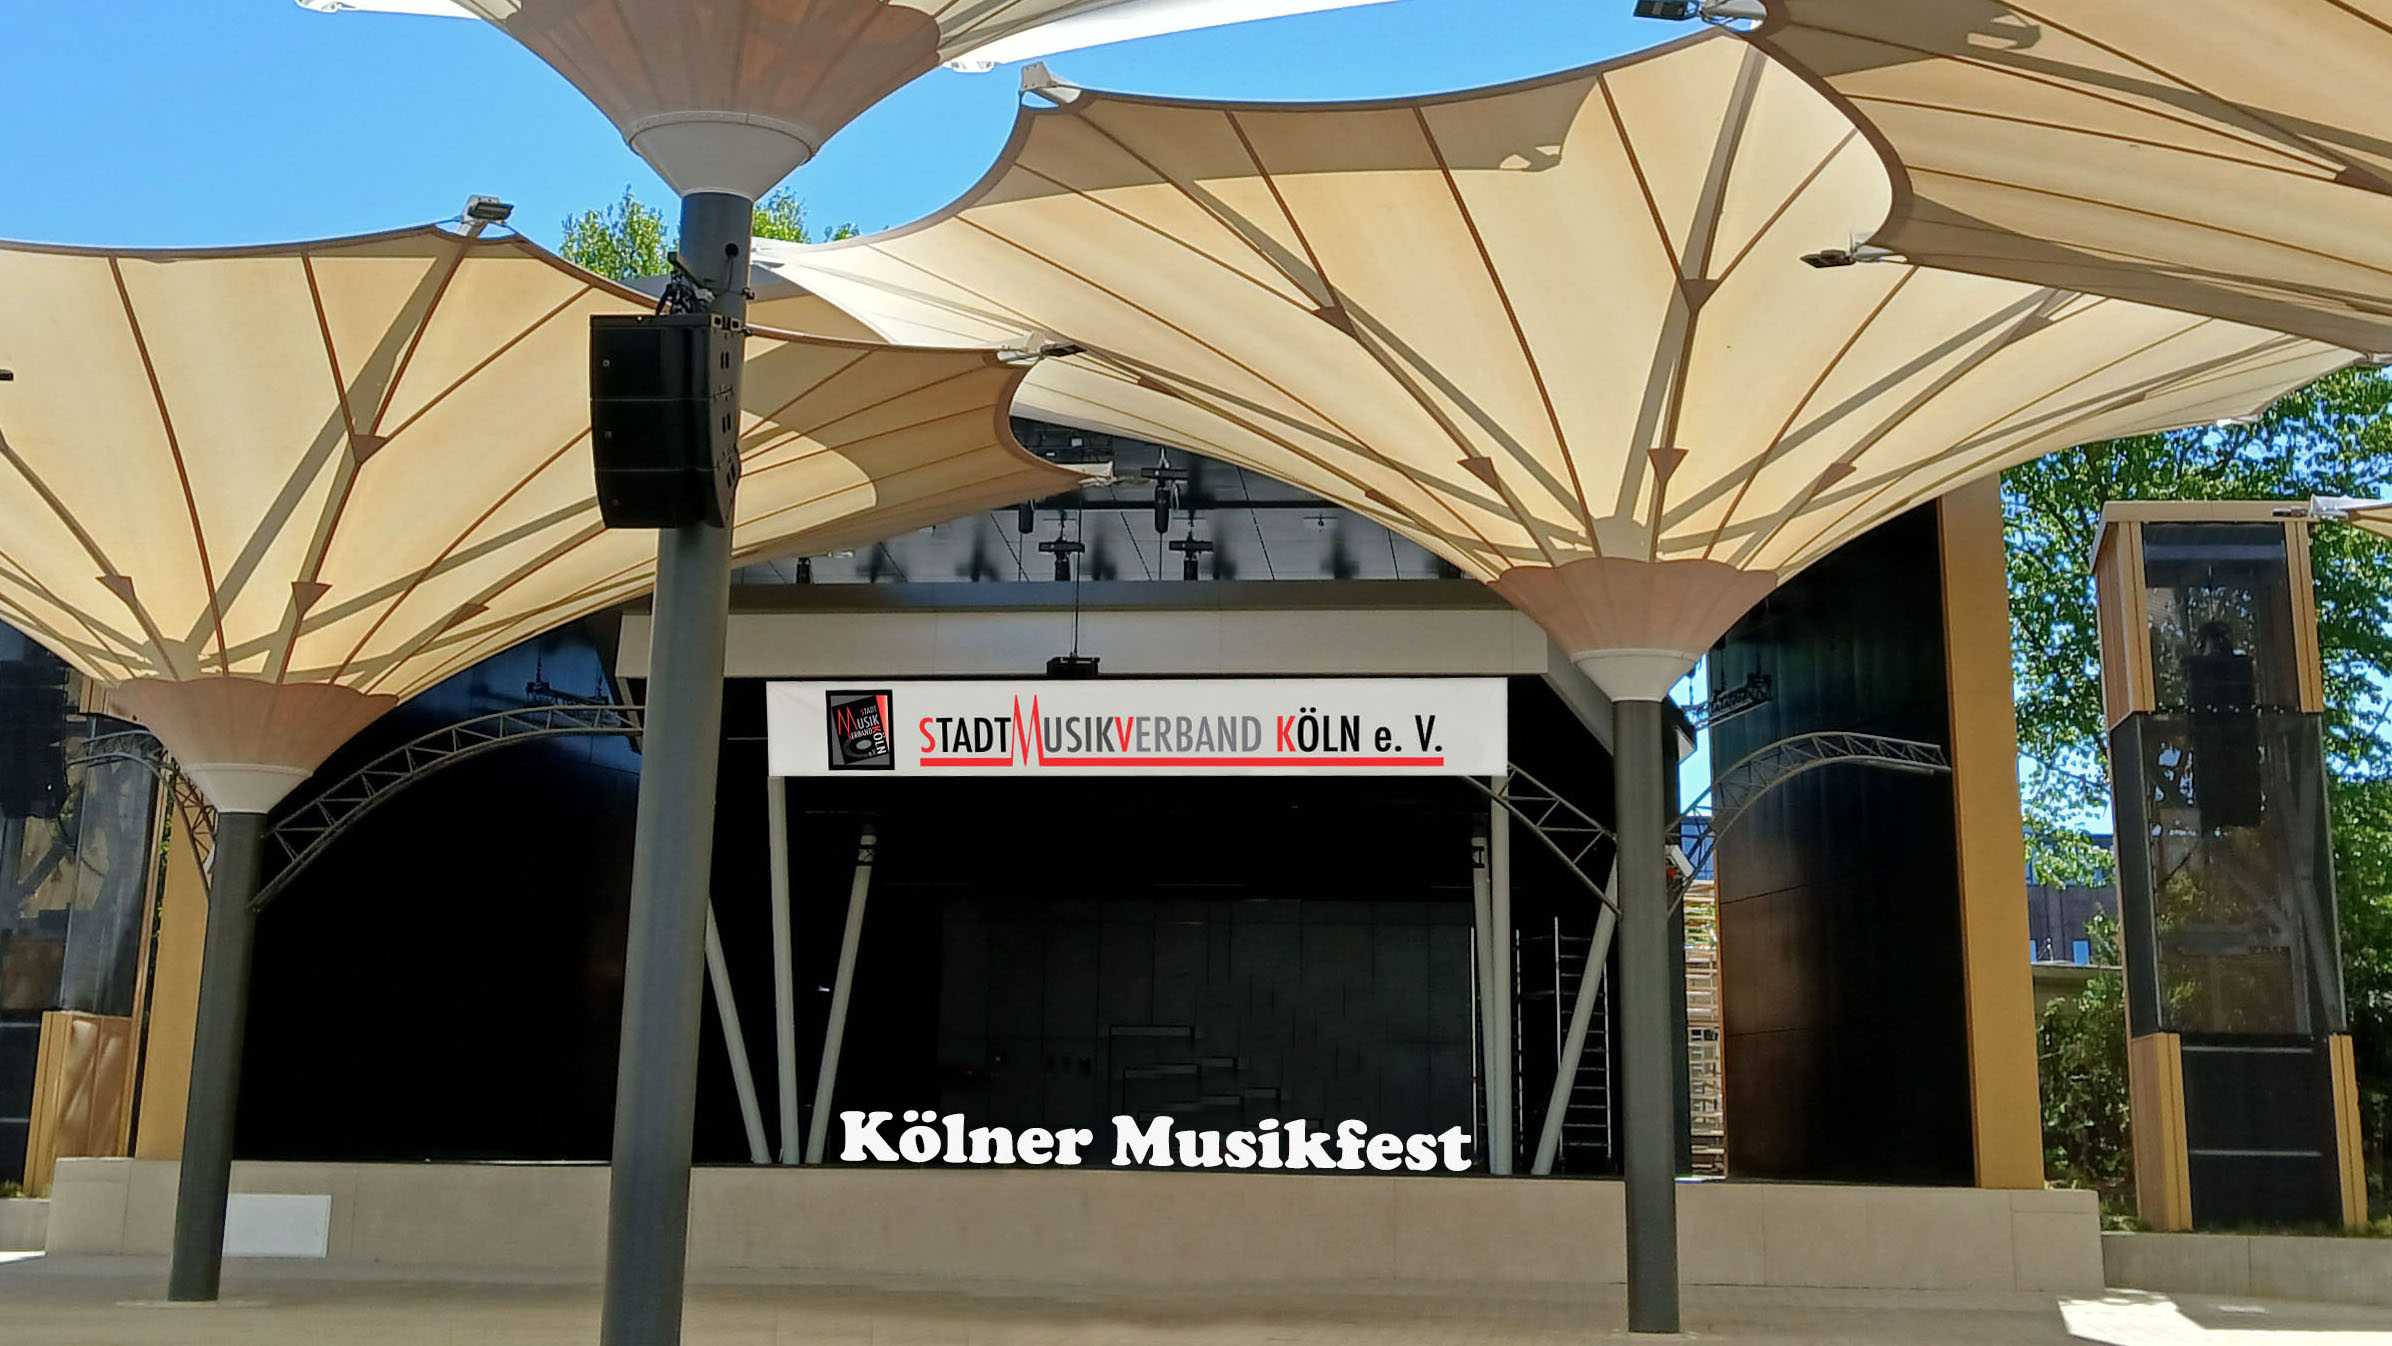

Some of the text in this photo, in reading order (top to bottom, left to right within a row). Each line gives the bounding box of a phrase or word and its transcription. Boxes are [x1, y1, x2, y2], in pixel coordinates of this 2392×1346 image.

[837, 706, 880, 736] MUSIK
[860, 706, 877, 716] STADT
[871, 725, 887, 754] KÖLN
[919, 695, 1443, 767] STADTMUSIKVERBAND KÖLN e. V.
[840, 1110, 1471, 1171] Kölner Musikfest
